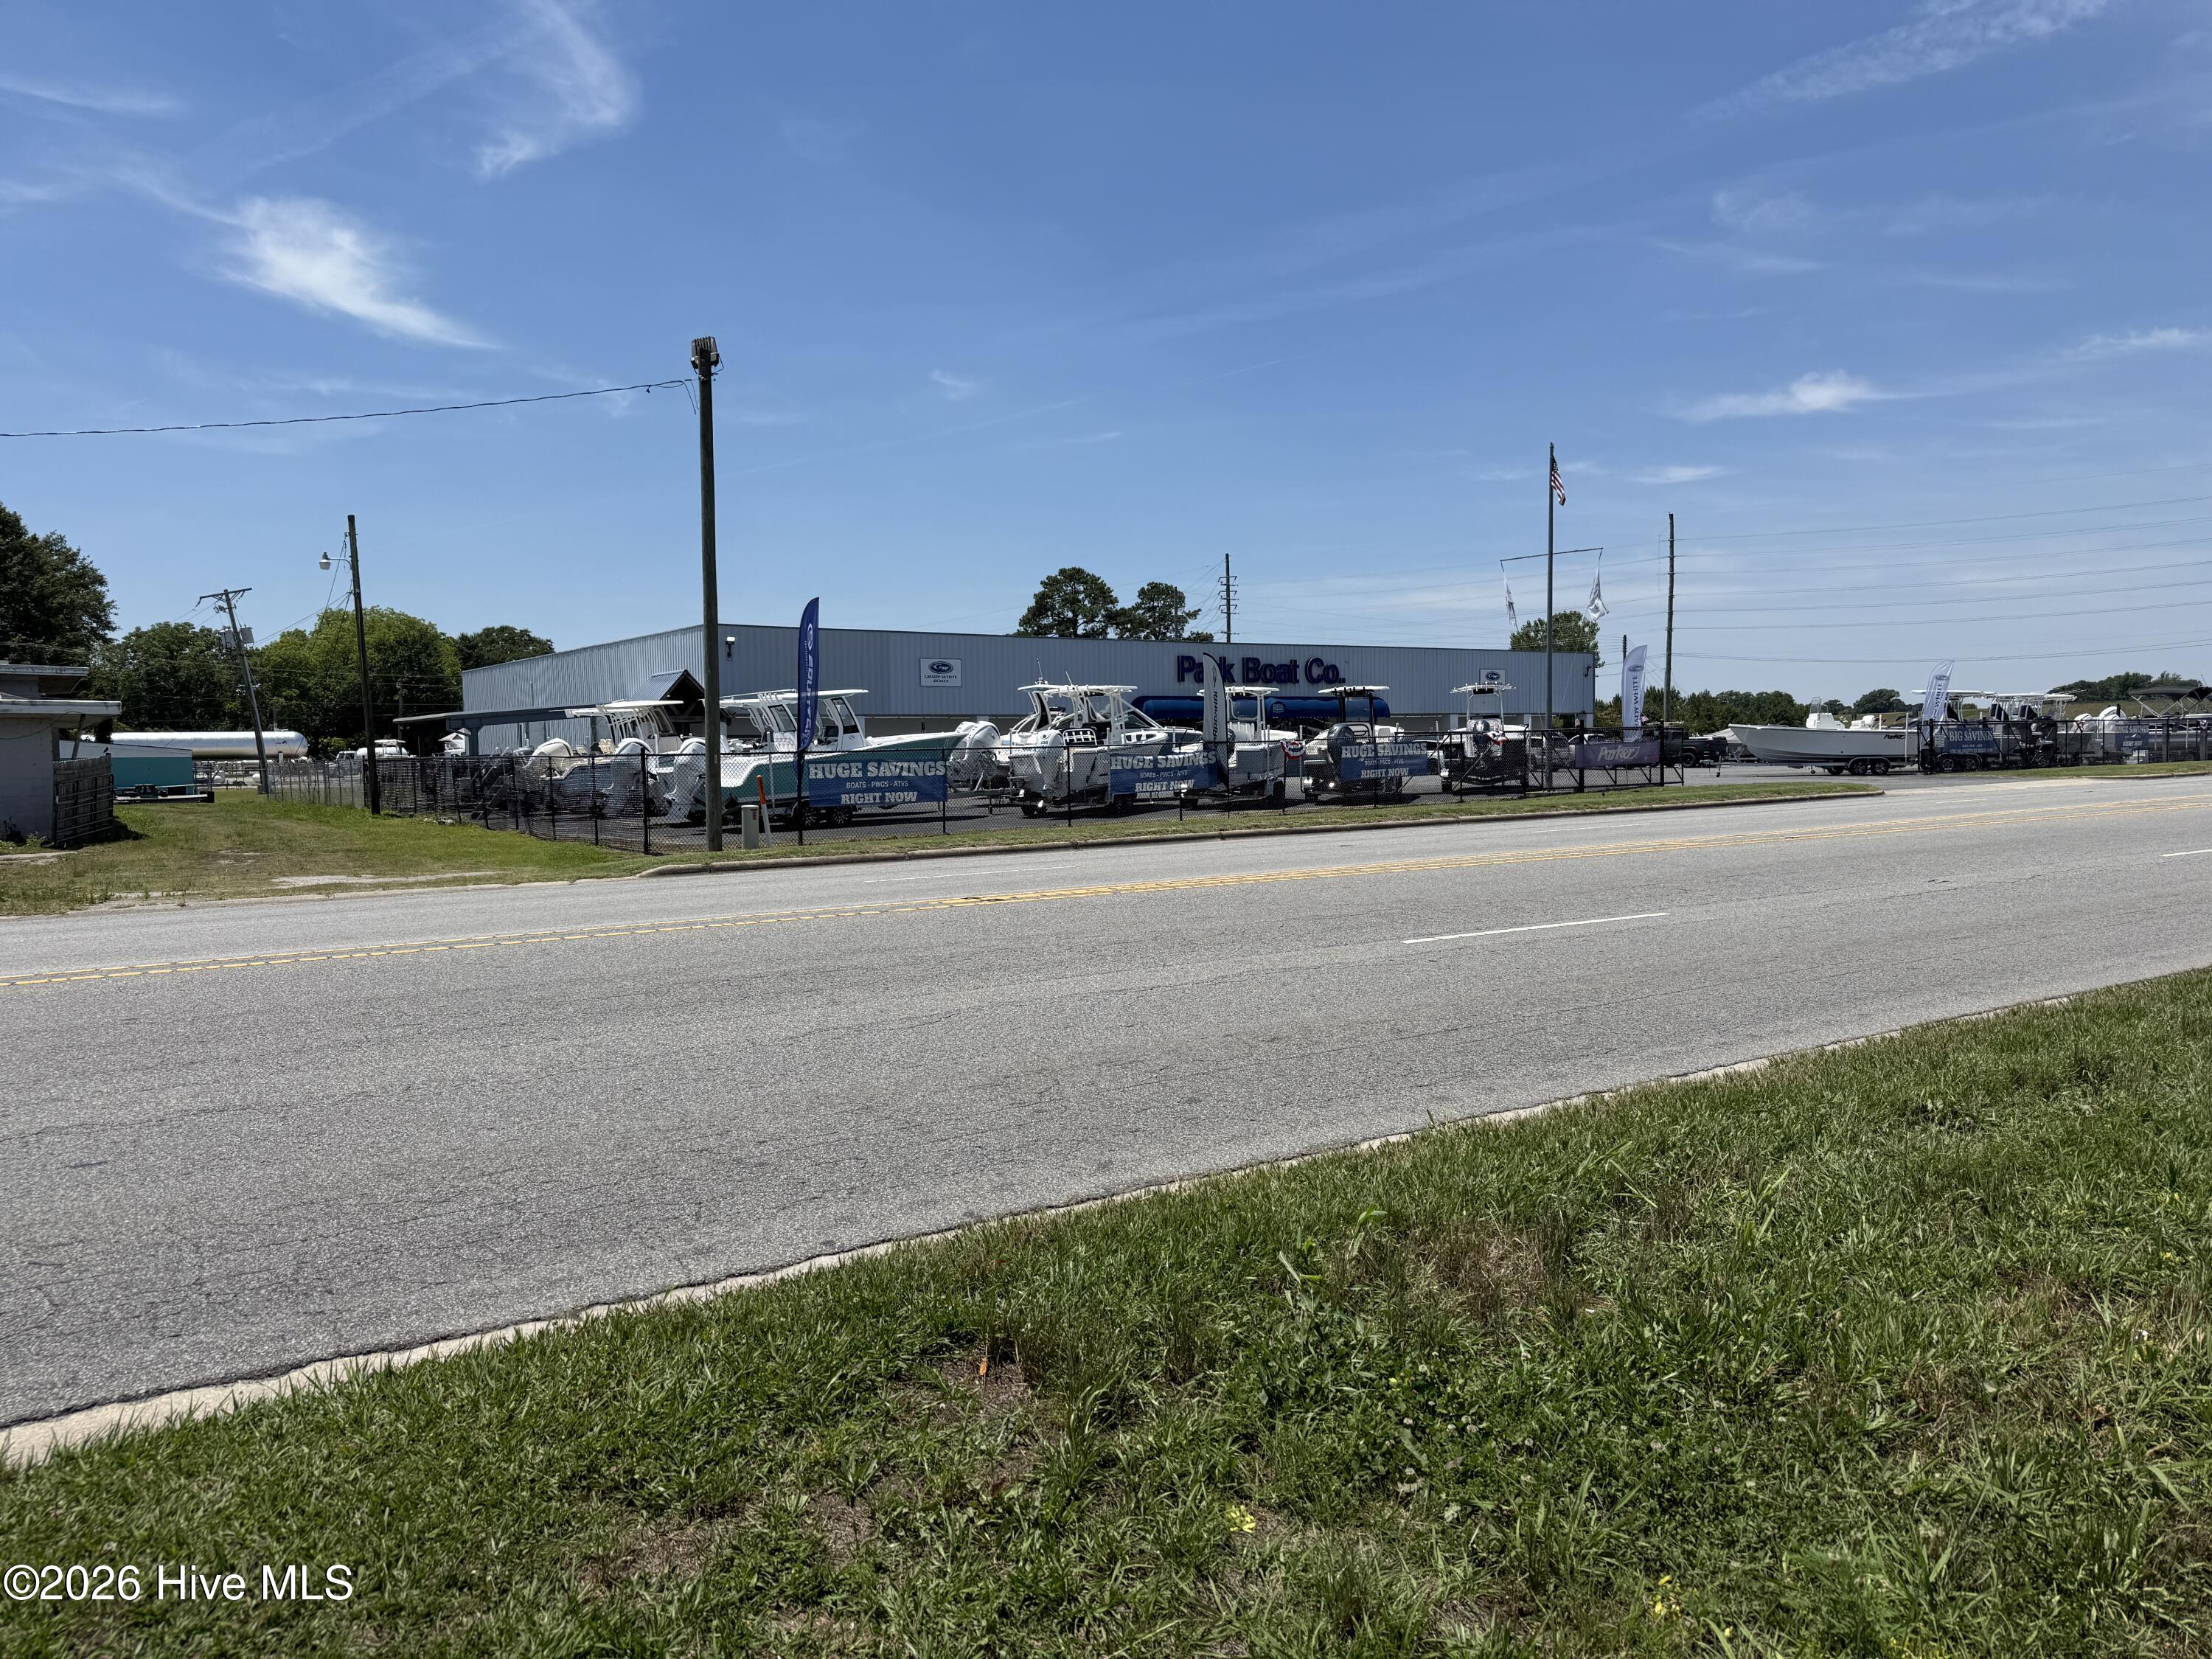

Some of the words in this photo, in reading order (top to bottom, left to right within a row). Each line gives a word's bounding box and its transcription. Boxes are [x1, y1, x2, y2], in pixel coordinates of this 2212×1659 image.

[1177, 655, 1236, 684] Pak
[1242, 656, 1299, 684] Boat
[1304, 657, 1346, 684] Co.
[1949, 731, 1963, 742] BIG
[1964, 730, 1993, 741] SAVINGS
[1342, 744, 1375, 758] HUGE
[1377, 742, 1427, 756] SAVINGS
[1597, 745, 1638, 761] Parker
[1110, 756, 1154, 770] HUGE
[1157, 751, 1216, 768] SAVINGS
[809, 762, 863, 779] HUGE
[867, 760, 946, 777] SAVINGS
[1361, 768, 1386, 779] RIGHT
[1388, 768, 1409, 777] NOW
[1135, 782, 1168, 792] RIGHT
[1169, 779, 1194, 790] NOW
[841, 792, 882, 804] RIGHT
[885, 791, 918, 802] NOW
